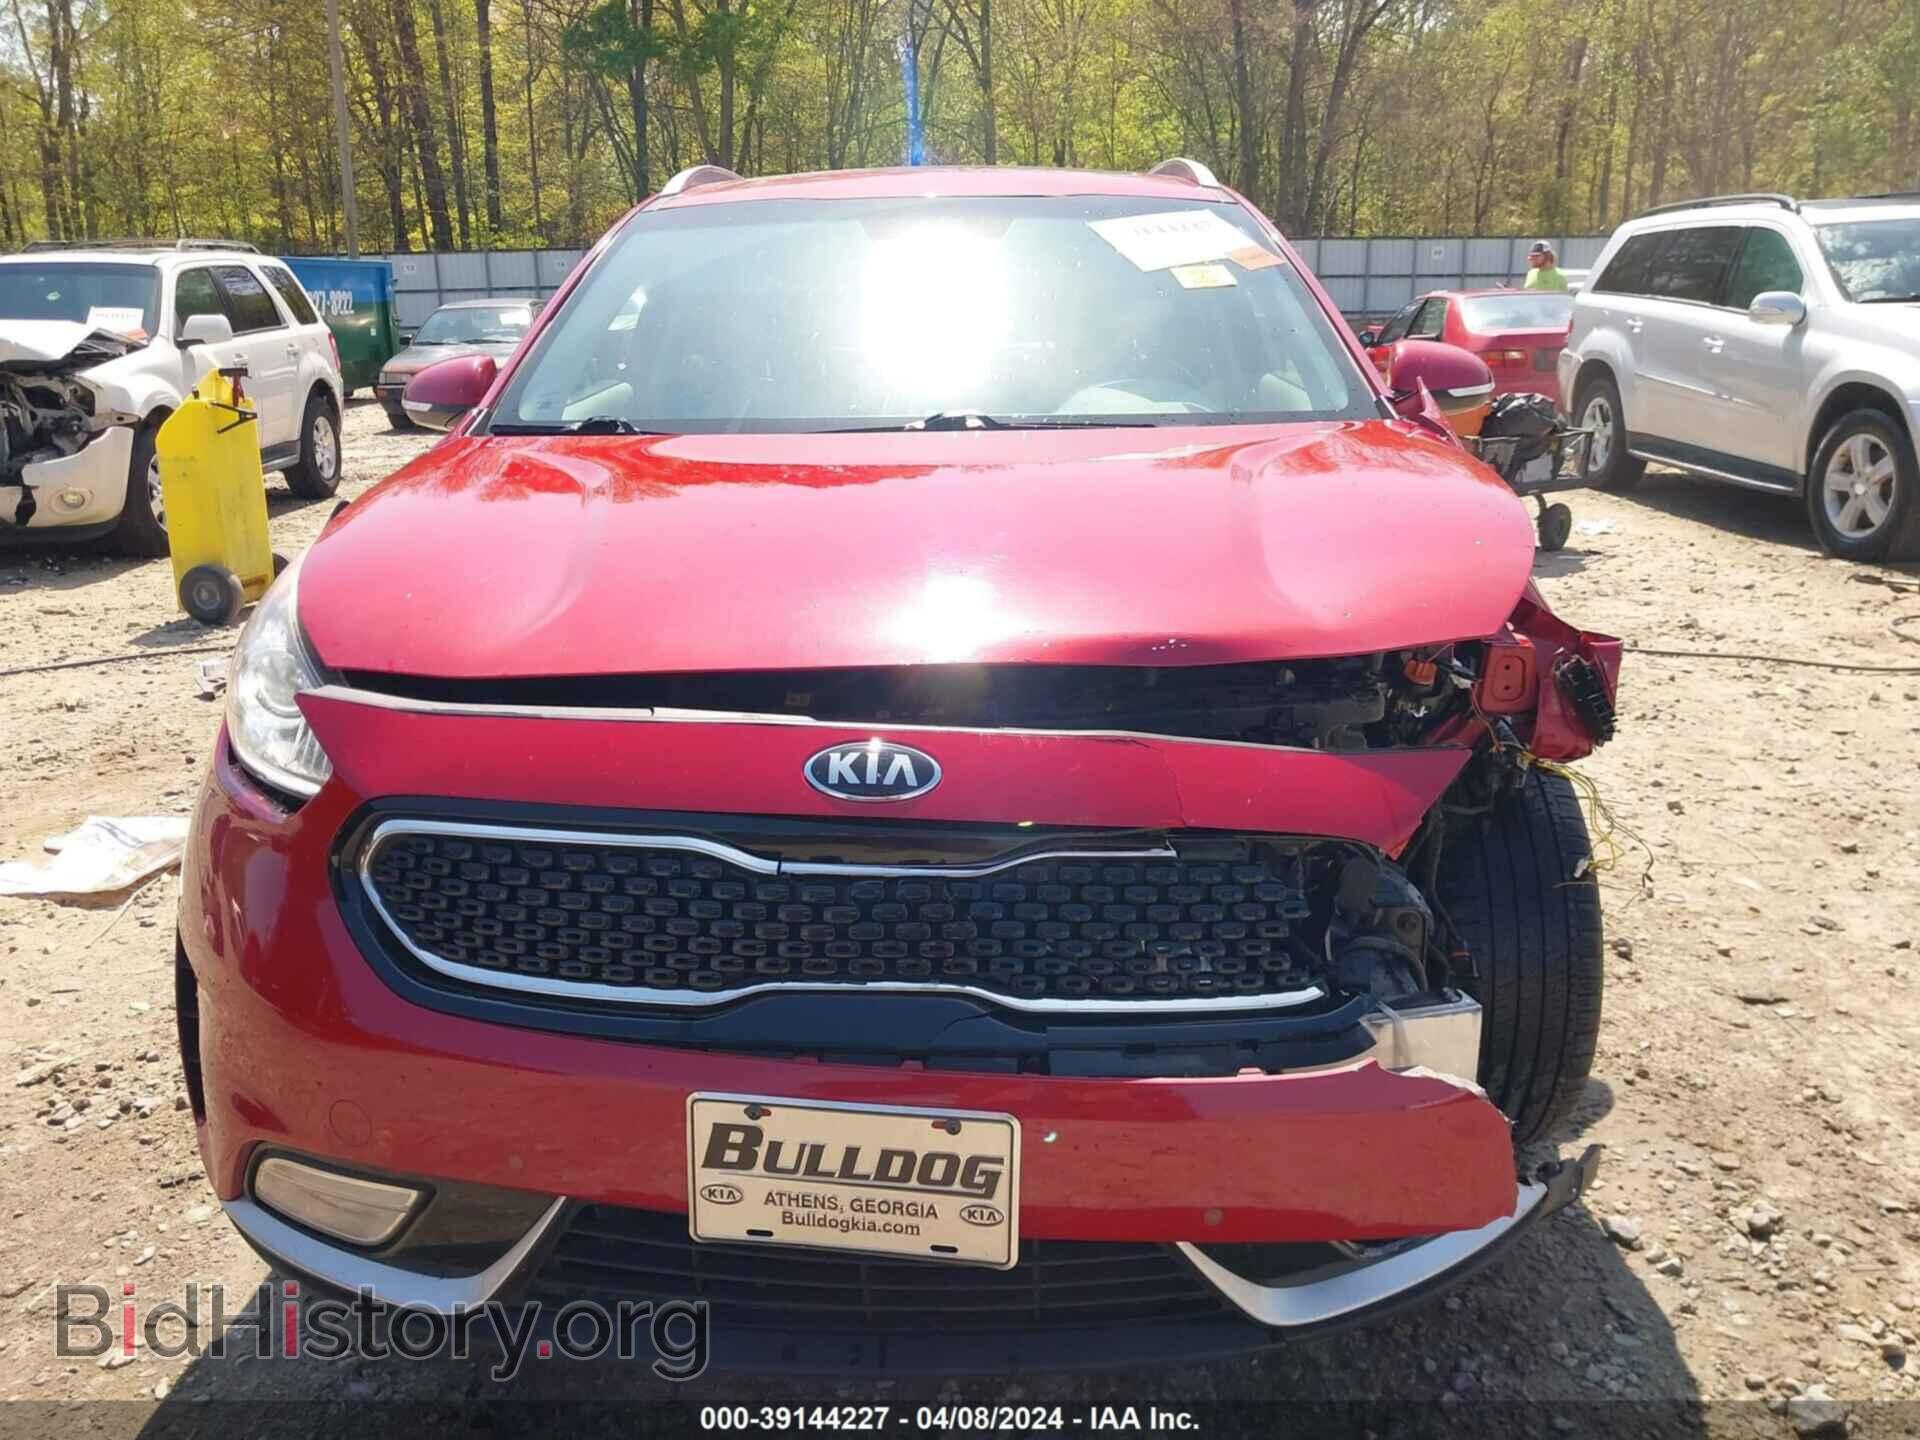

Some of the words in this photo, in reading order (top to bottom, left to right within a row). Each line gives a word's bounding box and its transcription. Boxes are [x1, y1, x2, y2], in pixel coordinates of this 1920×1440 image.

[828, 752, 918, 786] KIA
[701, 1122, 1005, 1199] BULLDOG
[707, 1187, 738, 1201] KIA
[763, 1190, 844, 1214] ATHENS,
[849, 1197, 939, 1220] GEORGIA
[781, 1210, 921, 1236] Bulldogkia.com
[966, 1208, 998, 1222] KIA
